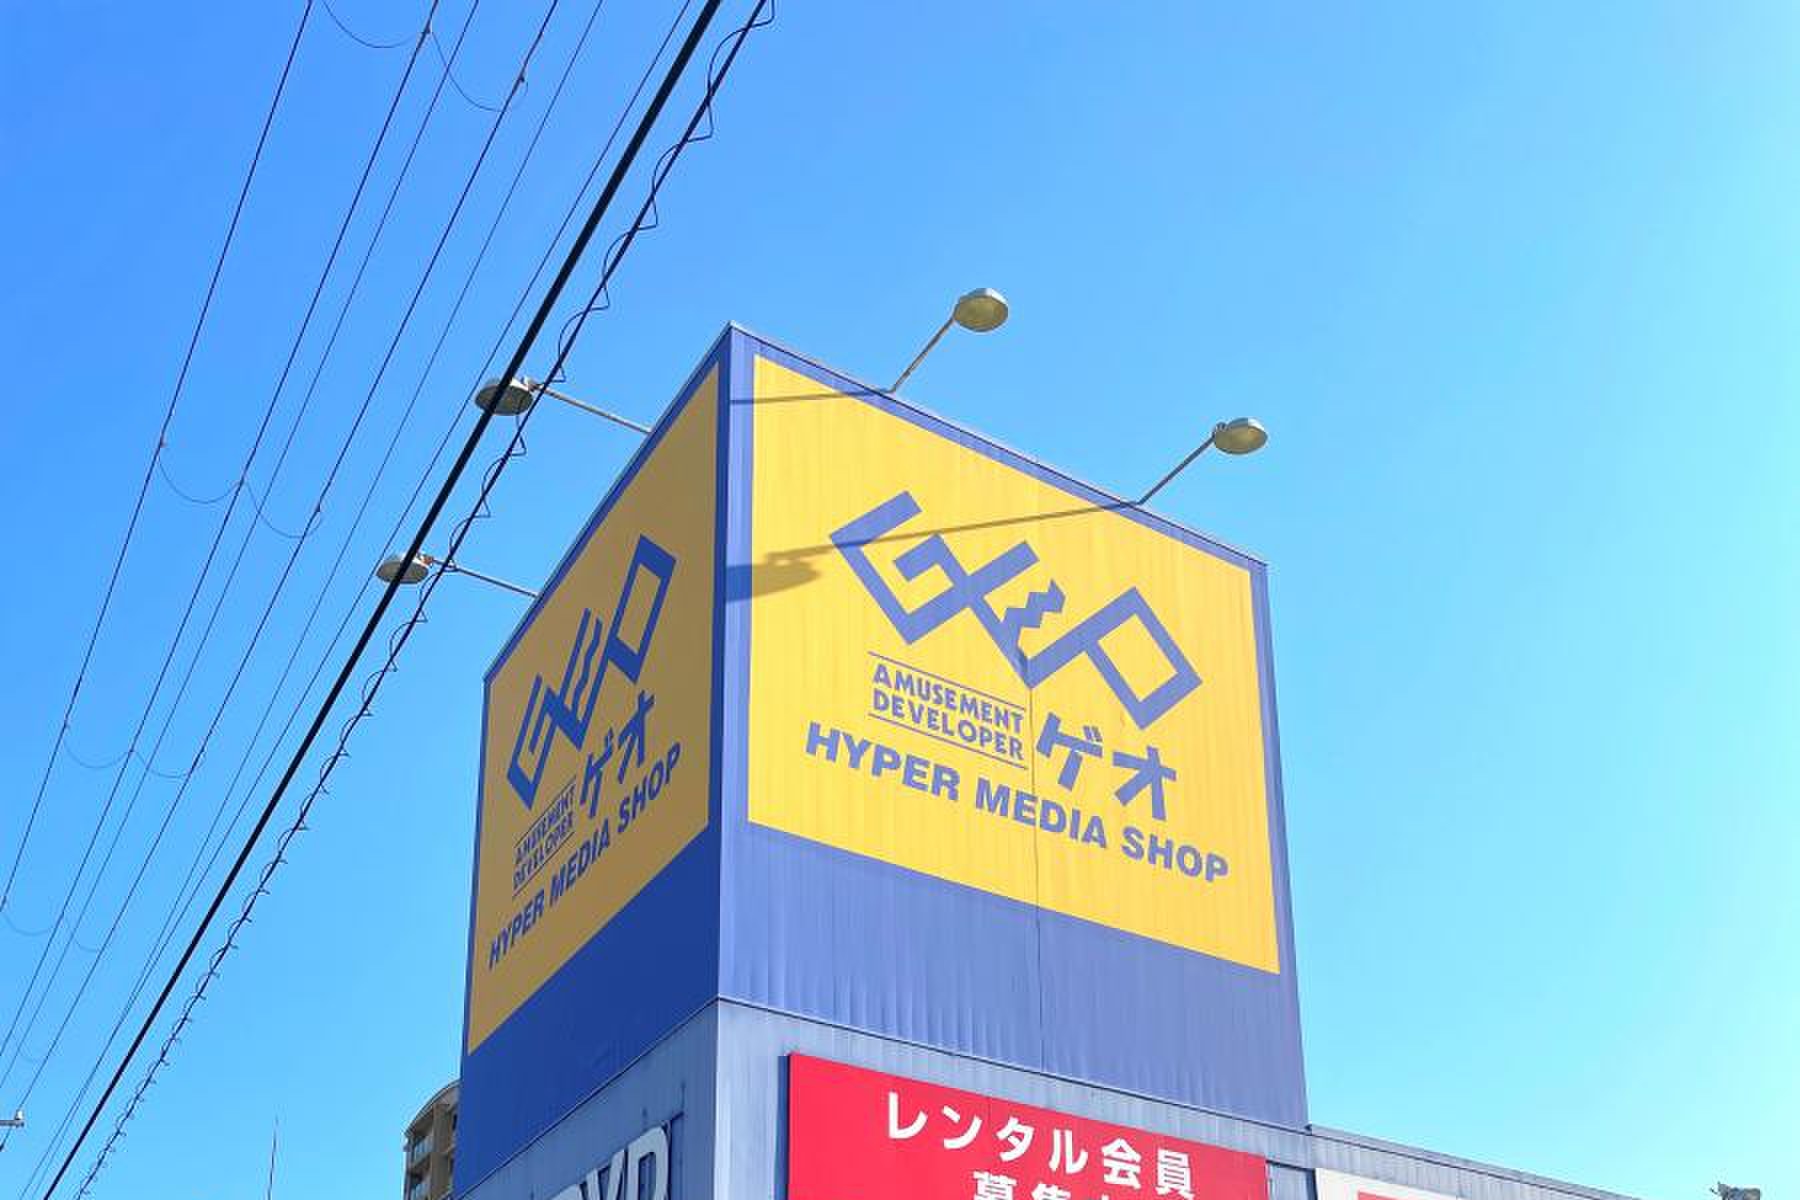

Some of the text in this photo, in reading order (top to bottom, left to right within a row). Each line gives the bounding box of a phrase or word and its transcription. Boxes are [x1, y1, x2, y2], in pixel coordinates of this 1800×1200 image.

[872, 662, 1025, 735] AMUSEMENT
[872, 689, 1025, 762] DEVELOPER
[579, 689, 655, 819] ゲオ
[805, 721, 1229, 883] HYPER MEDIA SHOP
[1036, 711, 1177, 821] ゲオ
[488, 742, 682, 970] HYPER MEDIA SHOP
[513, 811, 574, 891] DEVELOPER
[515, 783, 577, 864] AMUSEMENT
[887, 1091, 1196, 1200] レンタル会員
